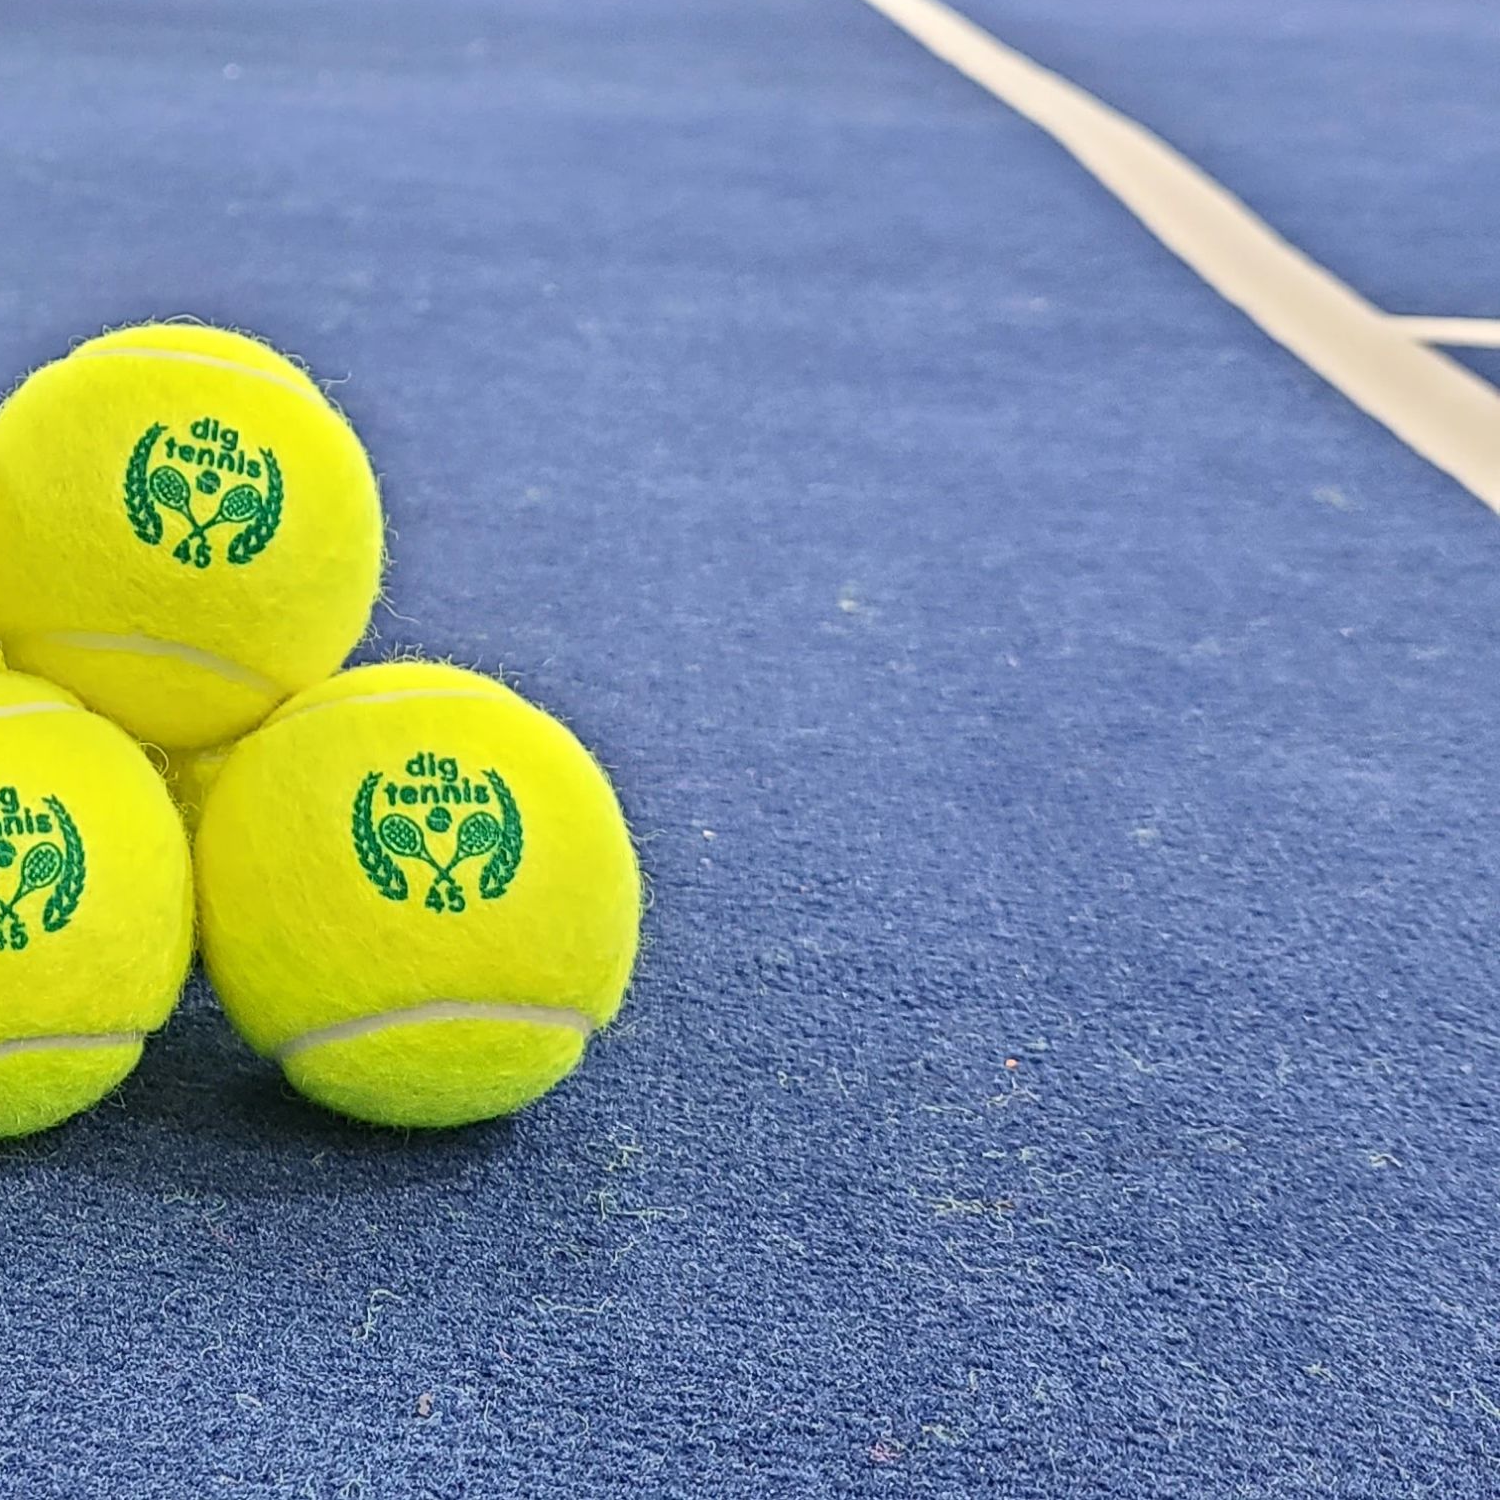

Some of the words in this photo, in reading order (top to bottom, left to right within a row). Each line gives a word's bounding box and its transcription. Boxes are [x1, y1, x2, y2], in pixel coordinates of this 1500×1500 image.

[190, 416, 239, 451] dig
[165, 436, 261, 478] tennis
[172, 539, 212, 568] 45
[405, 752, 458, 782] dig
[384, 777, 490, 806] tennis
[425, 885, 466, 913] 45
